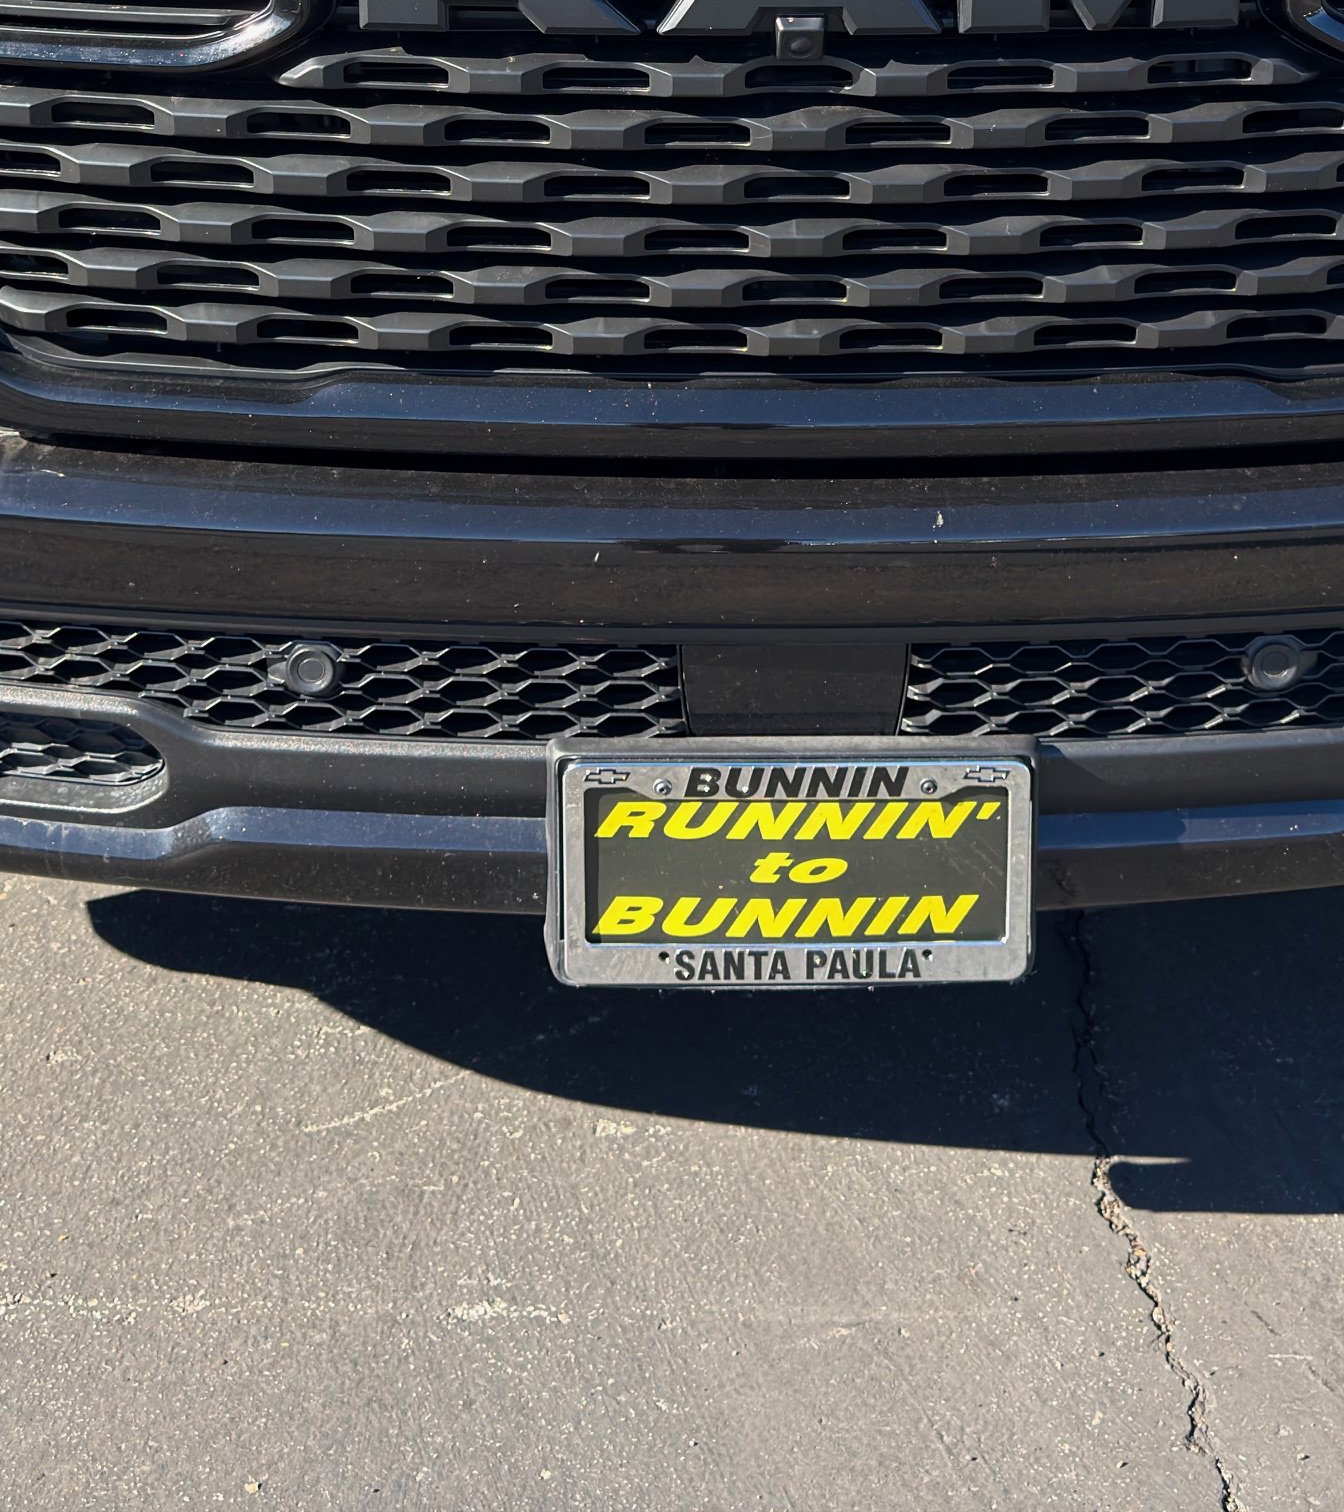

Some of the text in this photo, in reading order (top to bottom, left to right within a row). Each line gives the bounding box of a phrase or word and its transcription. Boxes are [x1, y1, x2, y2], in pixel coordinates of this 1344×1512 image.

[683, 766, 910, 798] BUNNIN
[594, 801, 1002, 841] RUNNIN'
[749, 852, 849, 884] to
[592, 894, 979, 938] BUNNIN
[674, 947, 922, 982] SANTA PAULA
